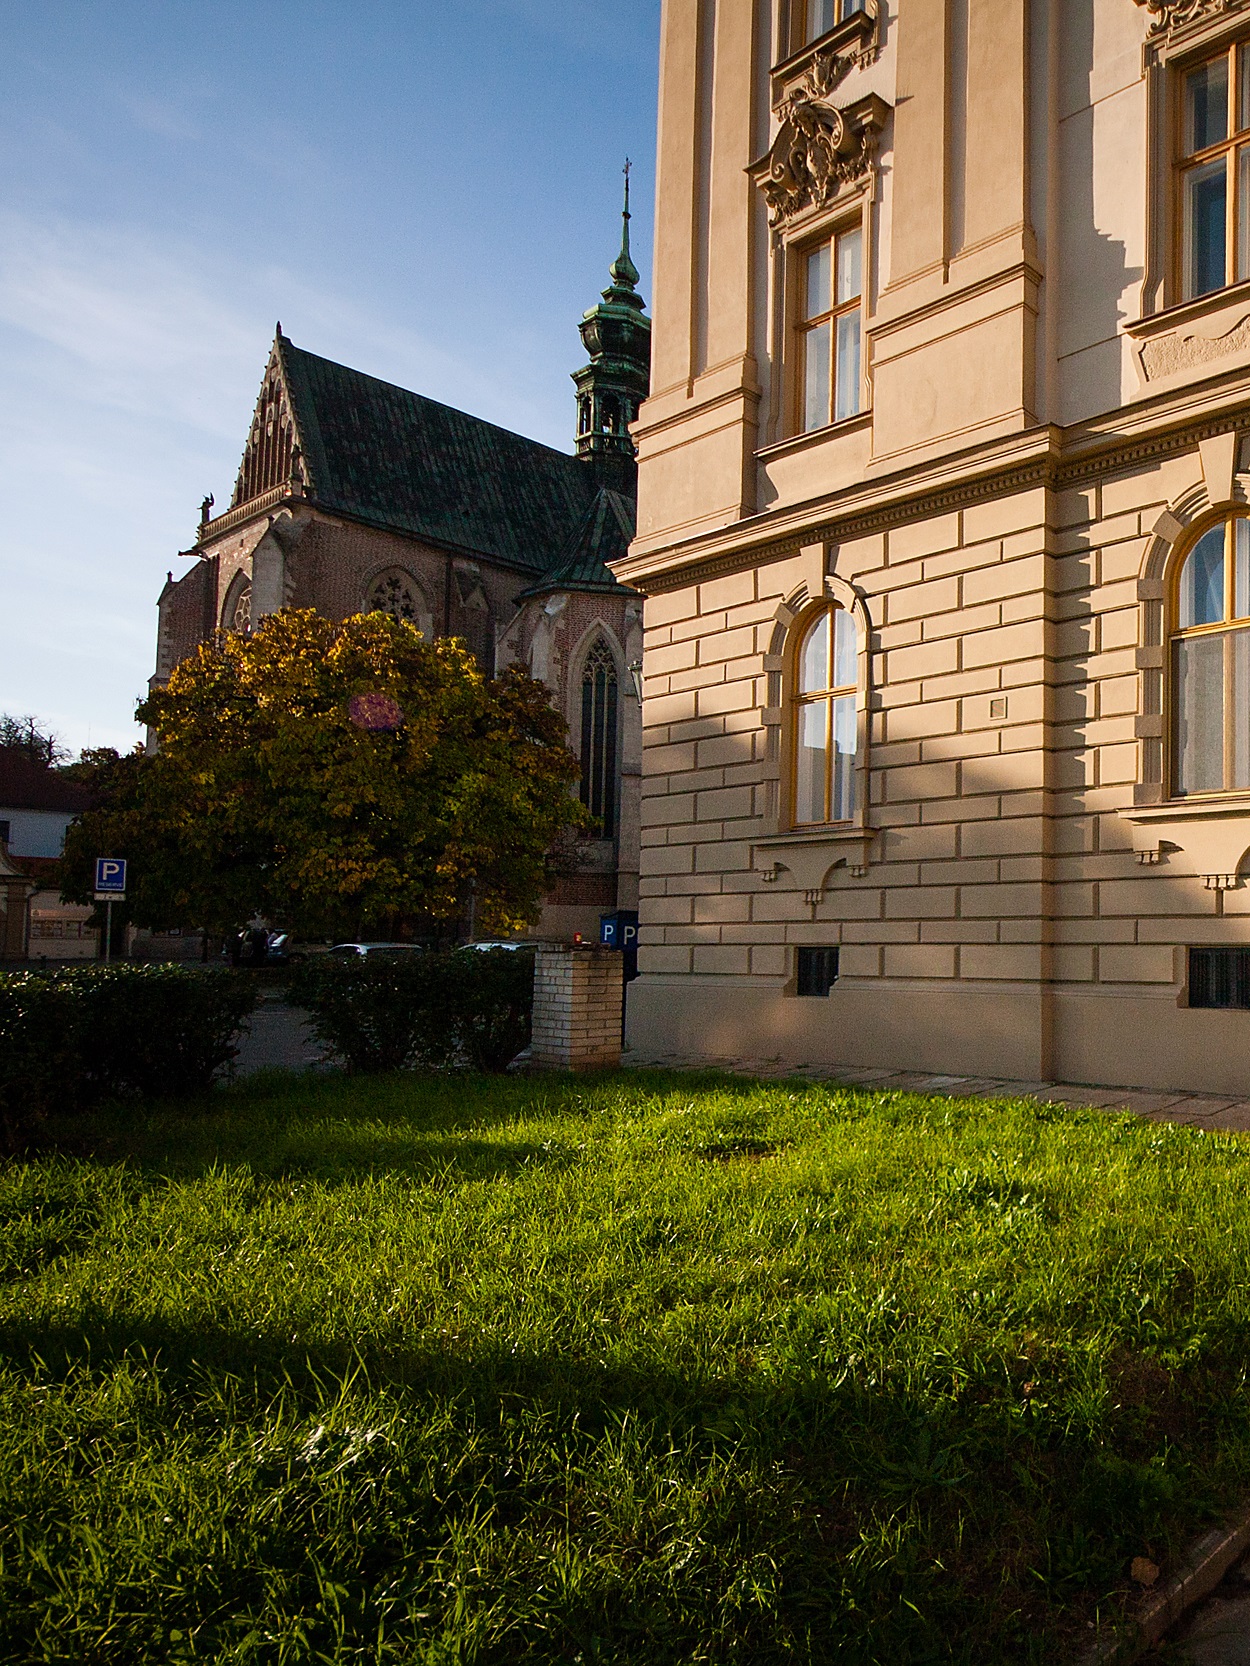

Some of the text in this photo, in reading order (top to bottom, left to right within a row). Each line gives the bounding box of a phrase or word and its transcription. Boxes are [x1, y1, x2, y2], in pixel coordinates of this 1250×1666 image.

[102, 862, 120, 881] P
[604, 924, 614, 941] P
[623, 925, 636, 945] P
